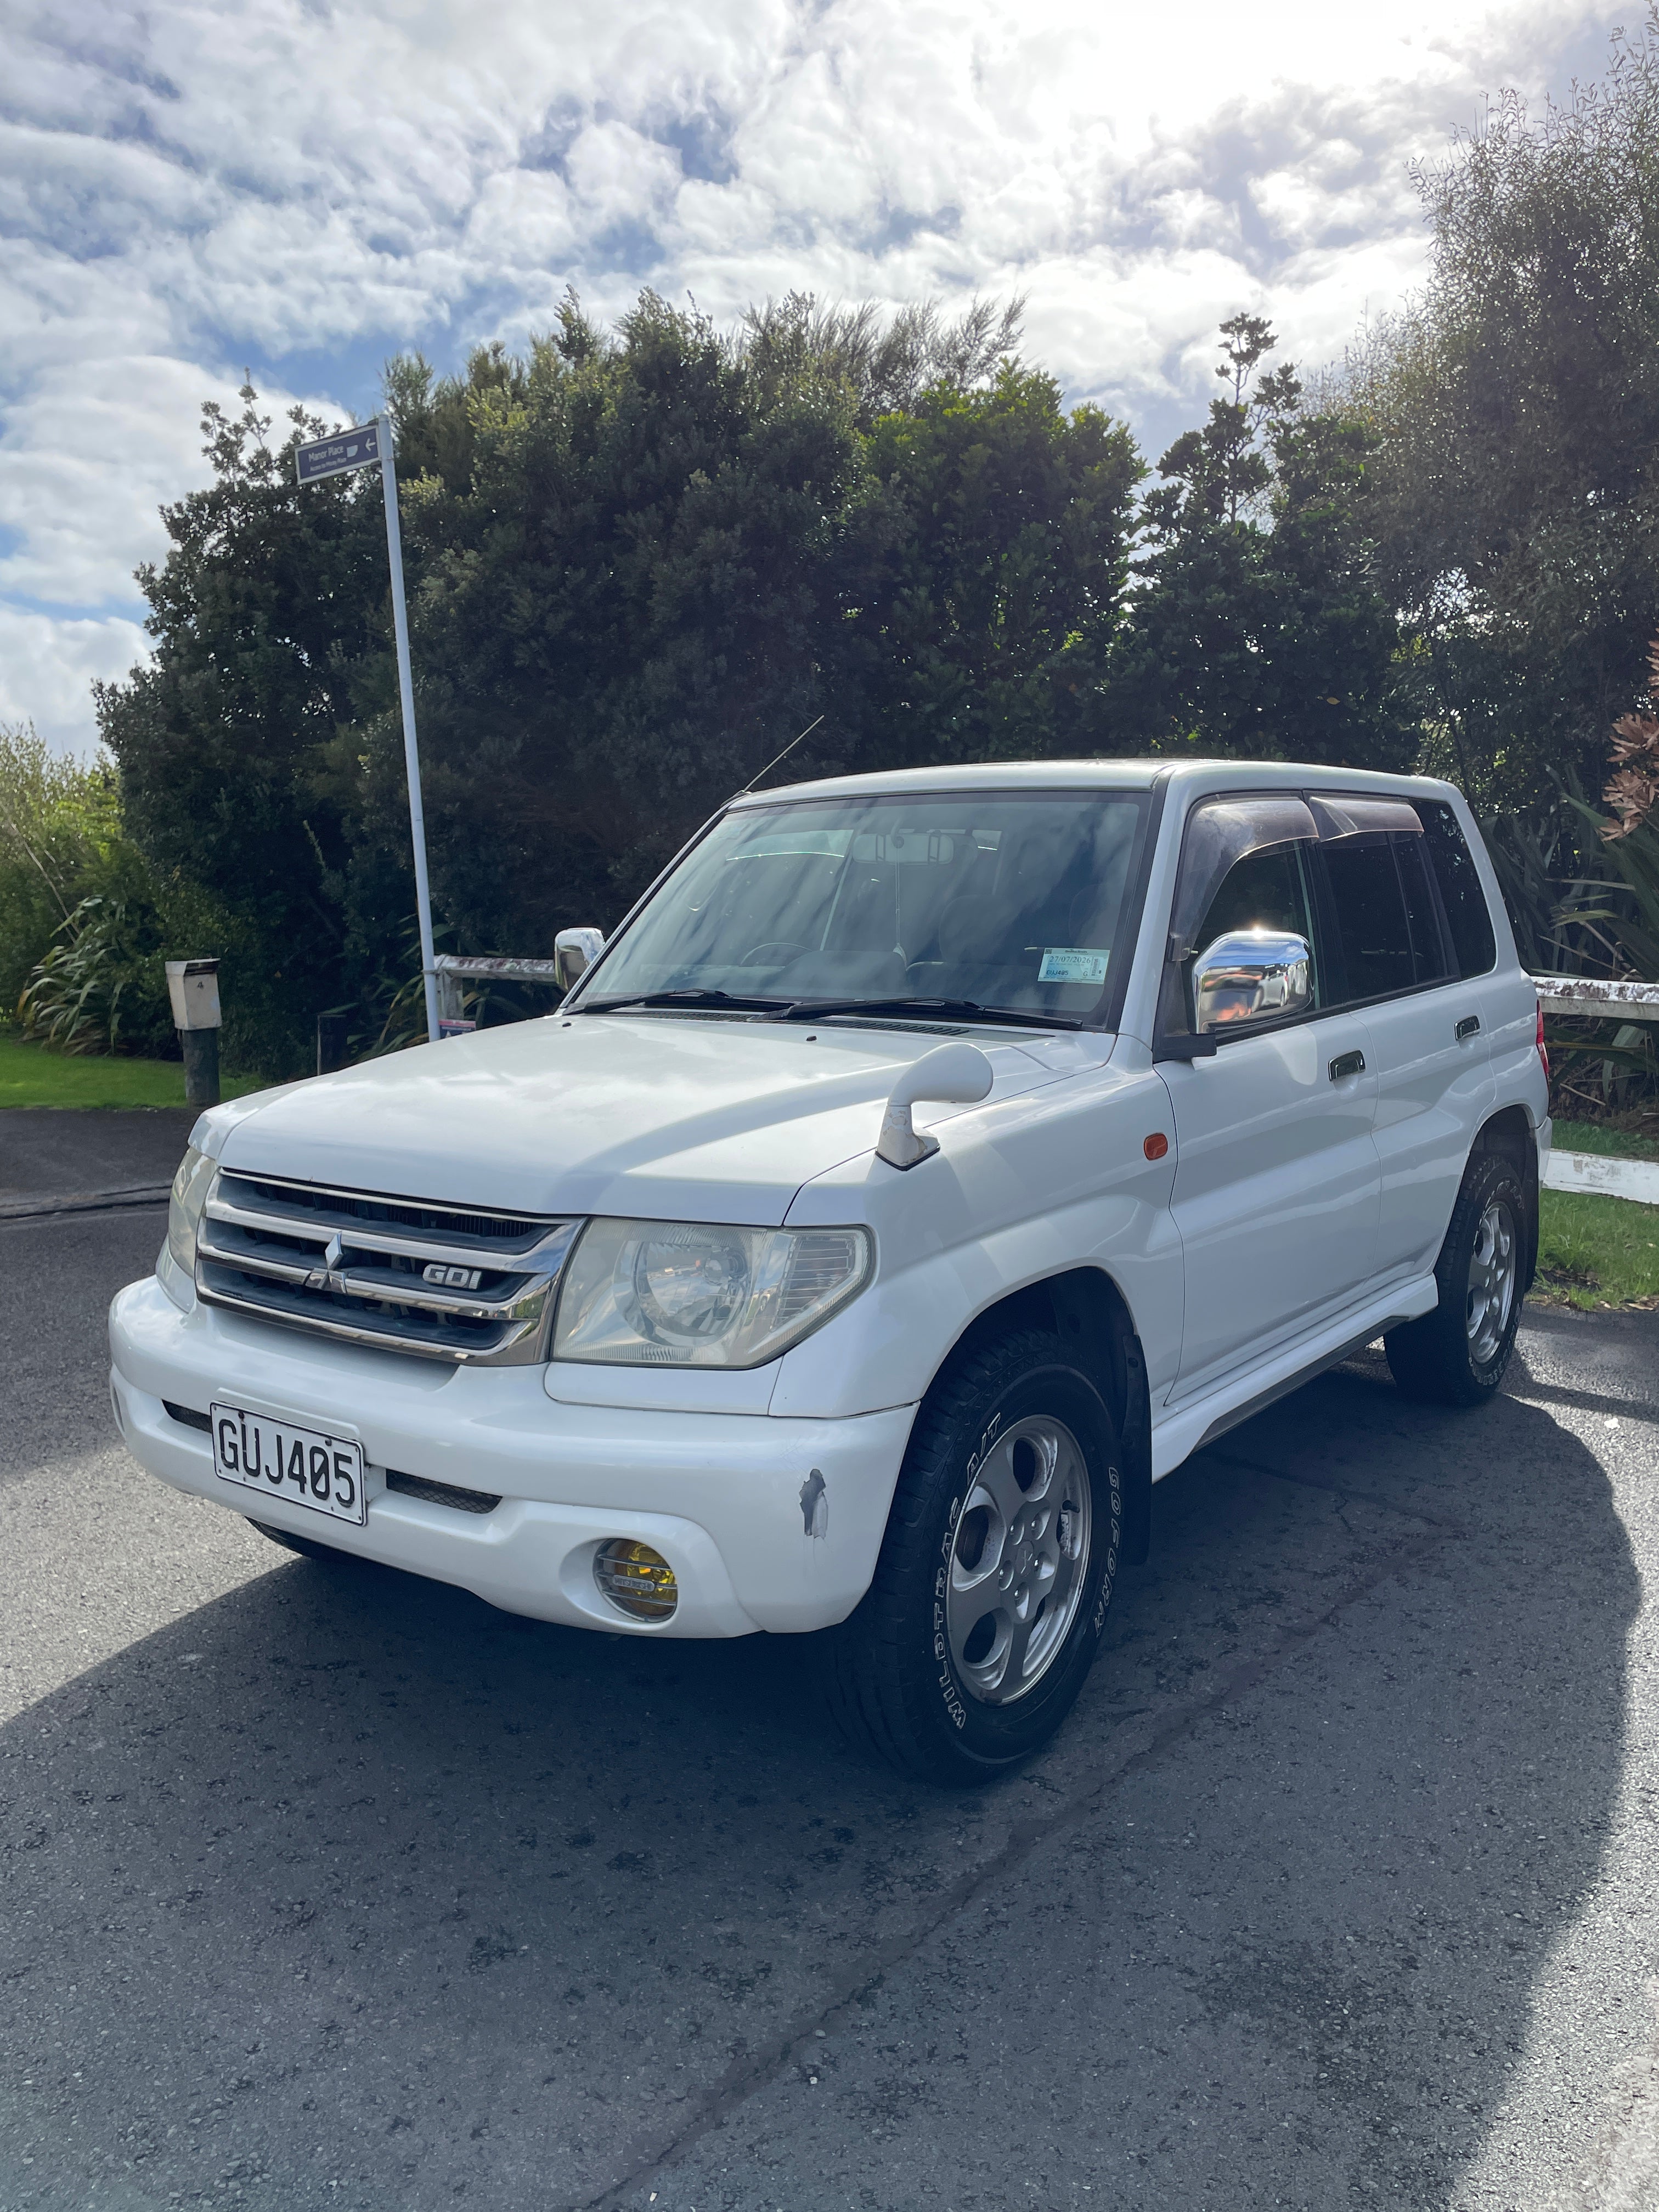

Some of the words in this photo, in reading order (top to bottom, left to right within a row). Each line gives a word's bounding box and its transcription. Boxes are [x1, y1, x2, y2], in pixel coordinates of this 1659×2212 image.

[328, 445, 344, 456] Place
[422, 1263, 482, 1290] GDI
[218, 1419, 356, 1508] GUJ405
[1094, 1466, 1122, 1638] GOFORM
[934, 1497, 966, 1729] WILDTRAC
